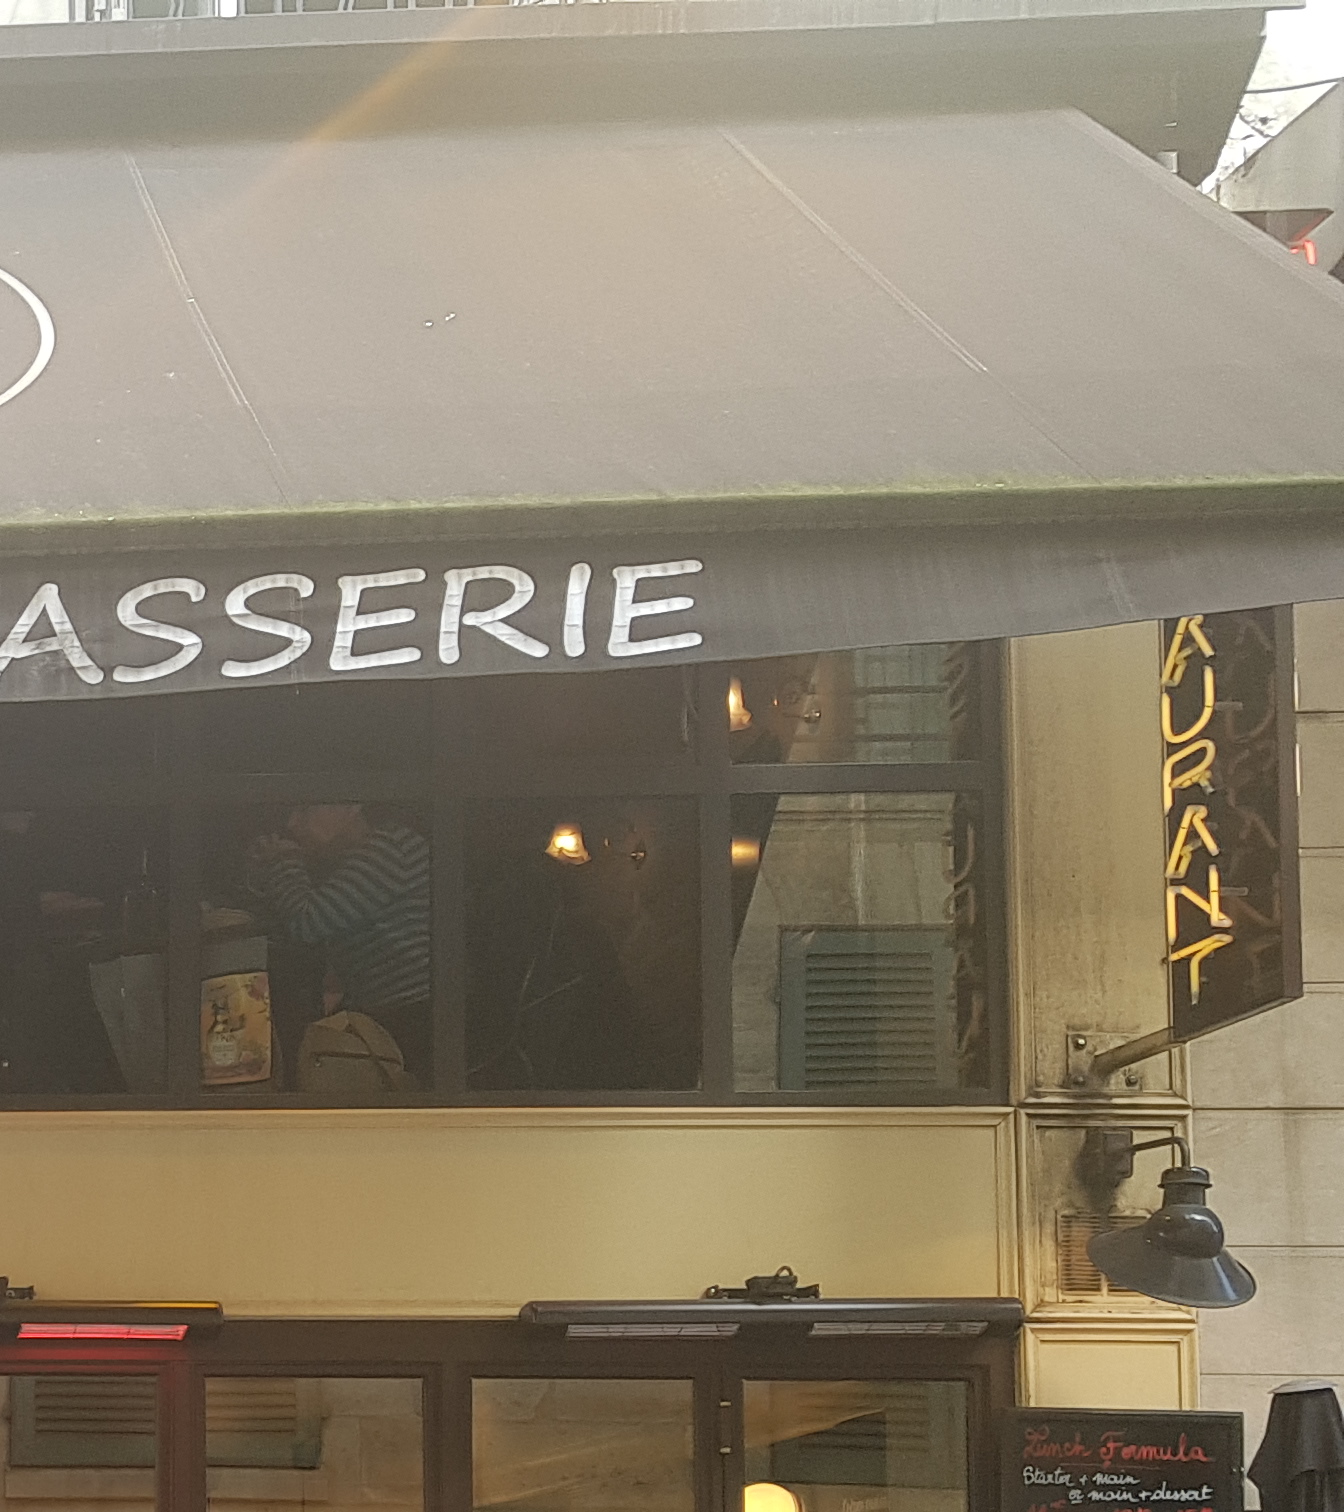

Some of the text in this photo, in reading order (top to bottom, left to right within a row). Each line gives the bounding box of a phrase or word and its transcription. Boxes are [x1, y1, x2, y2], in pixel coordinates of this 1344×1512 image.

[1099, 1431, 1215, 1464] Formula
[1023, 1466, 1141, 1487] Starter main
[1087, 1487, 1139, 1503] main
